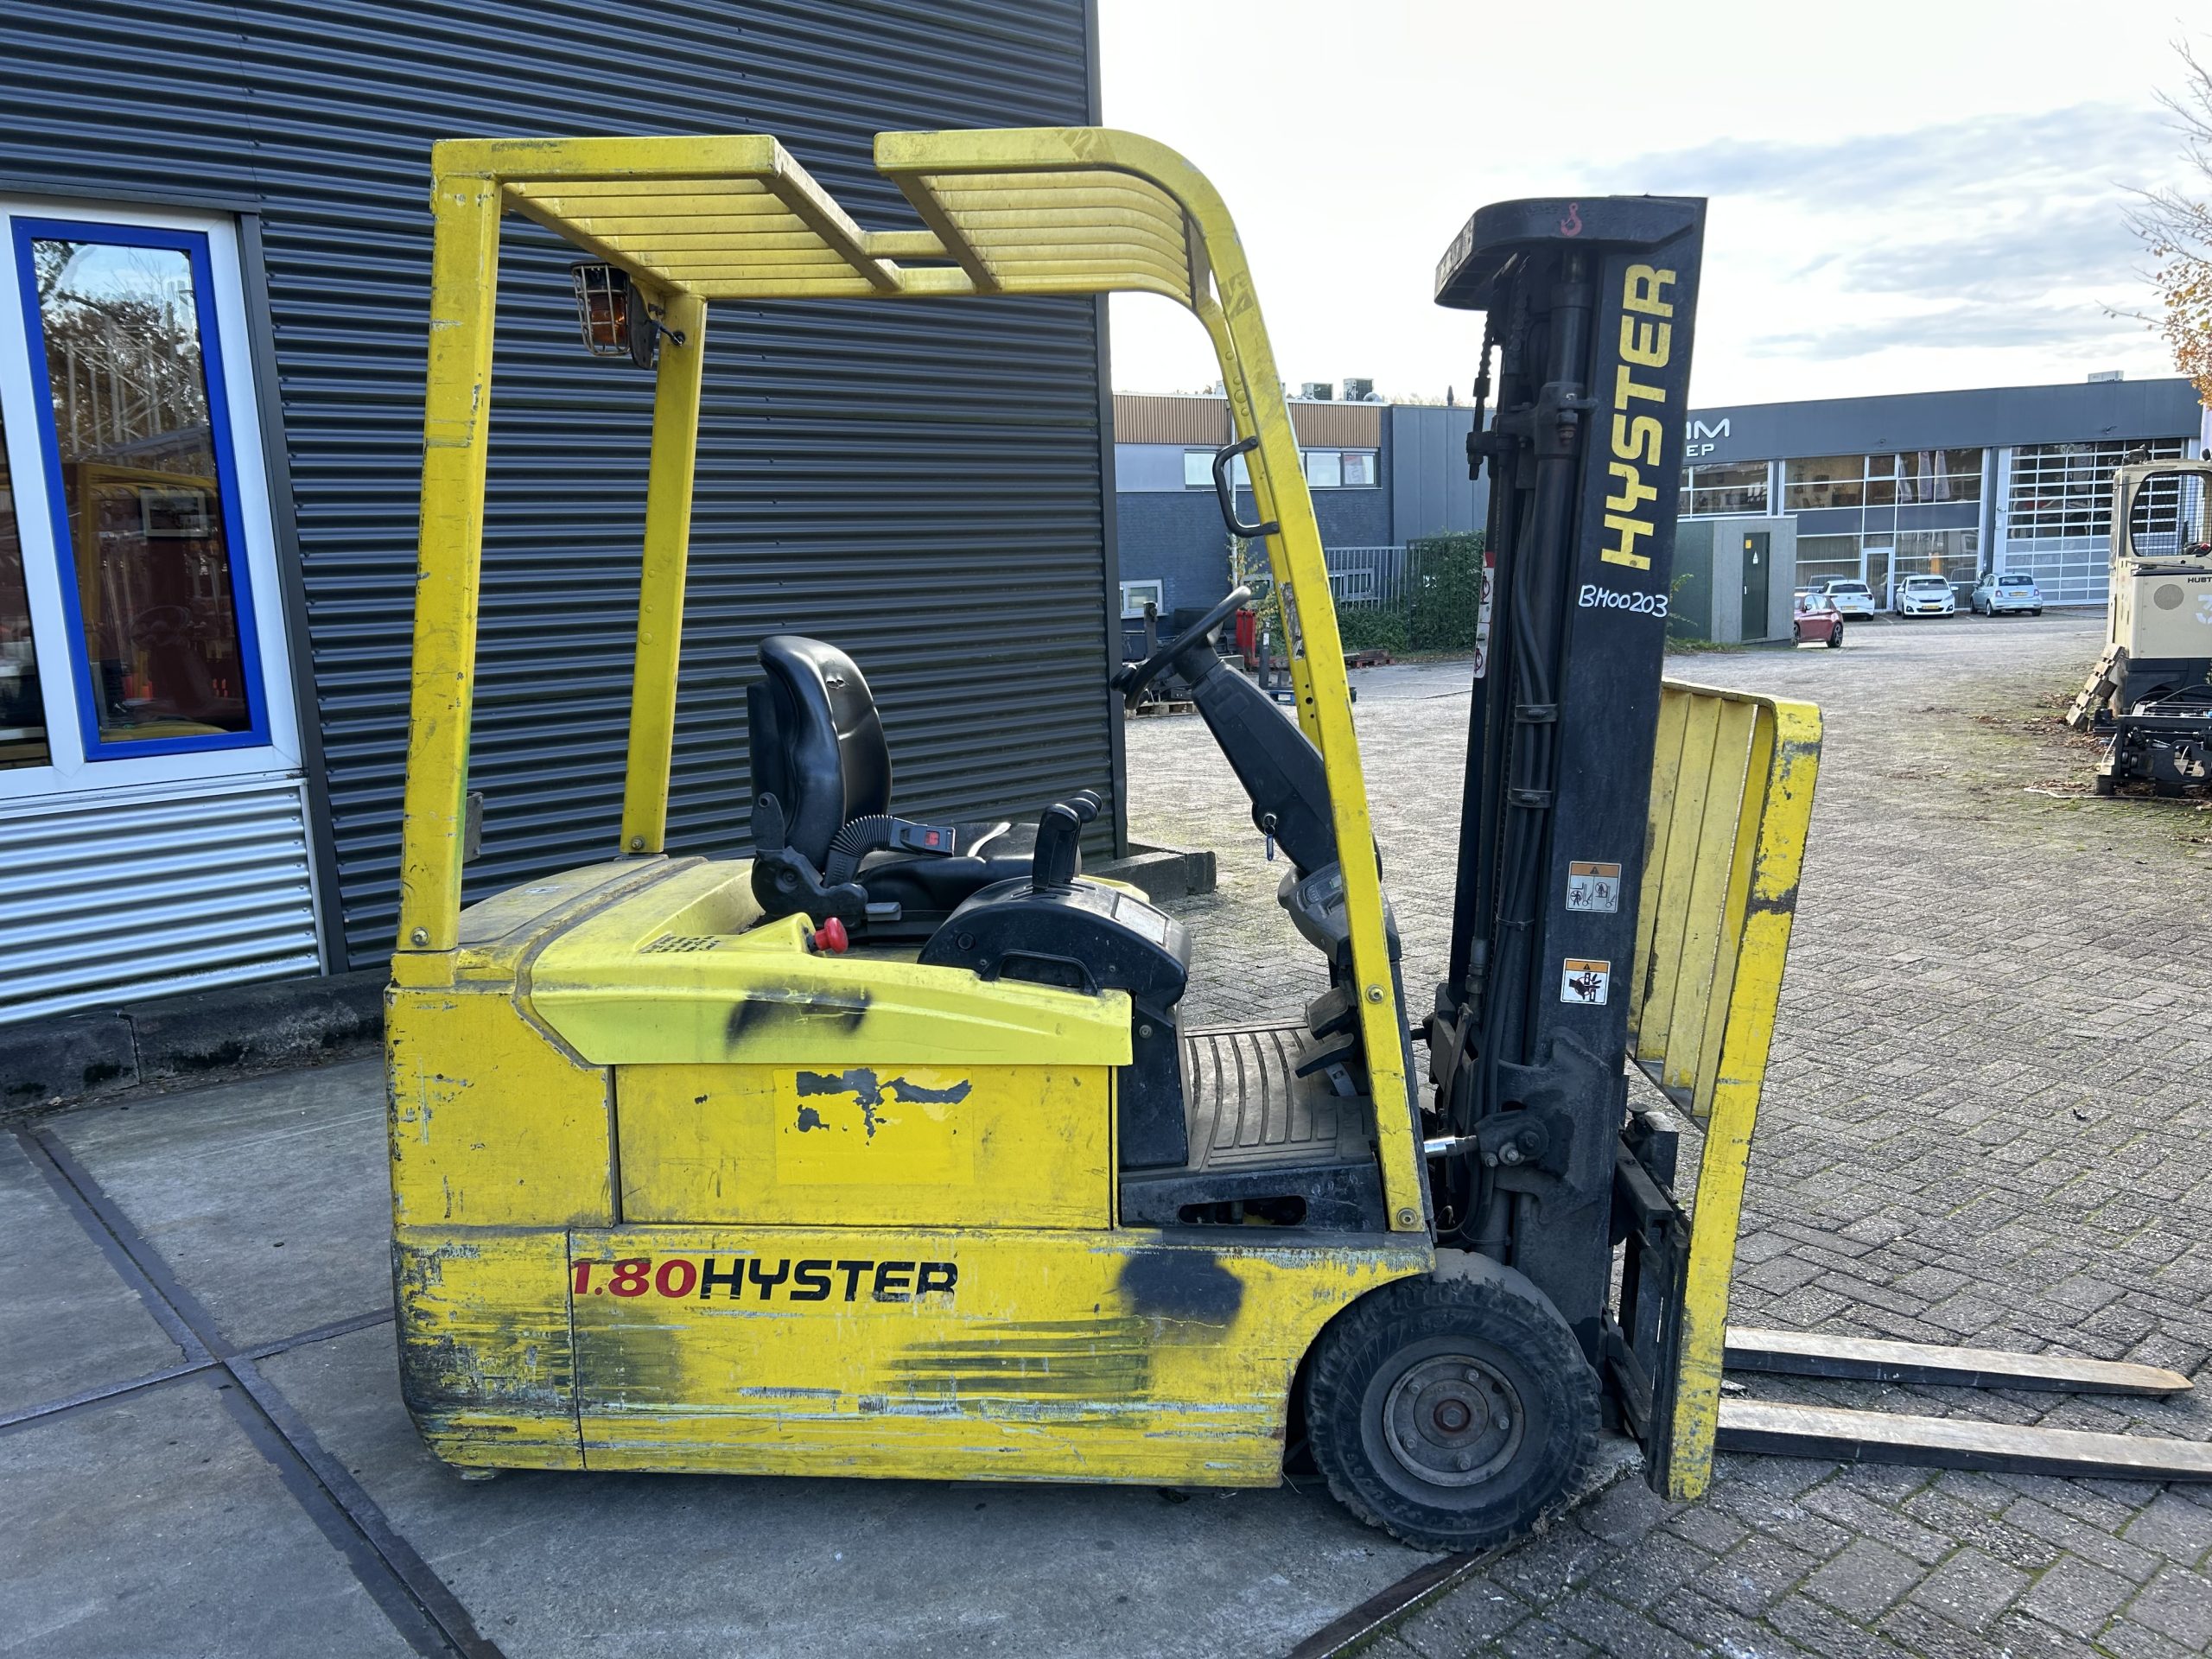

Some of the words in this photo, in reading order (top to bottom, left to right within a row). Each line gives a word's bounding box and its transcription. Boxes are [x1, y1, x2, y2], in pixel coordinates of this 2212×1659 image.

[1601, 264, 1676, 571] HYSTER
[1579, 585, 1669, 617] BM00203
[572, 1258, 697, 1298] 1.80
[699, 1258, 958, 1302] HYSTER
